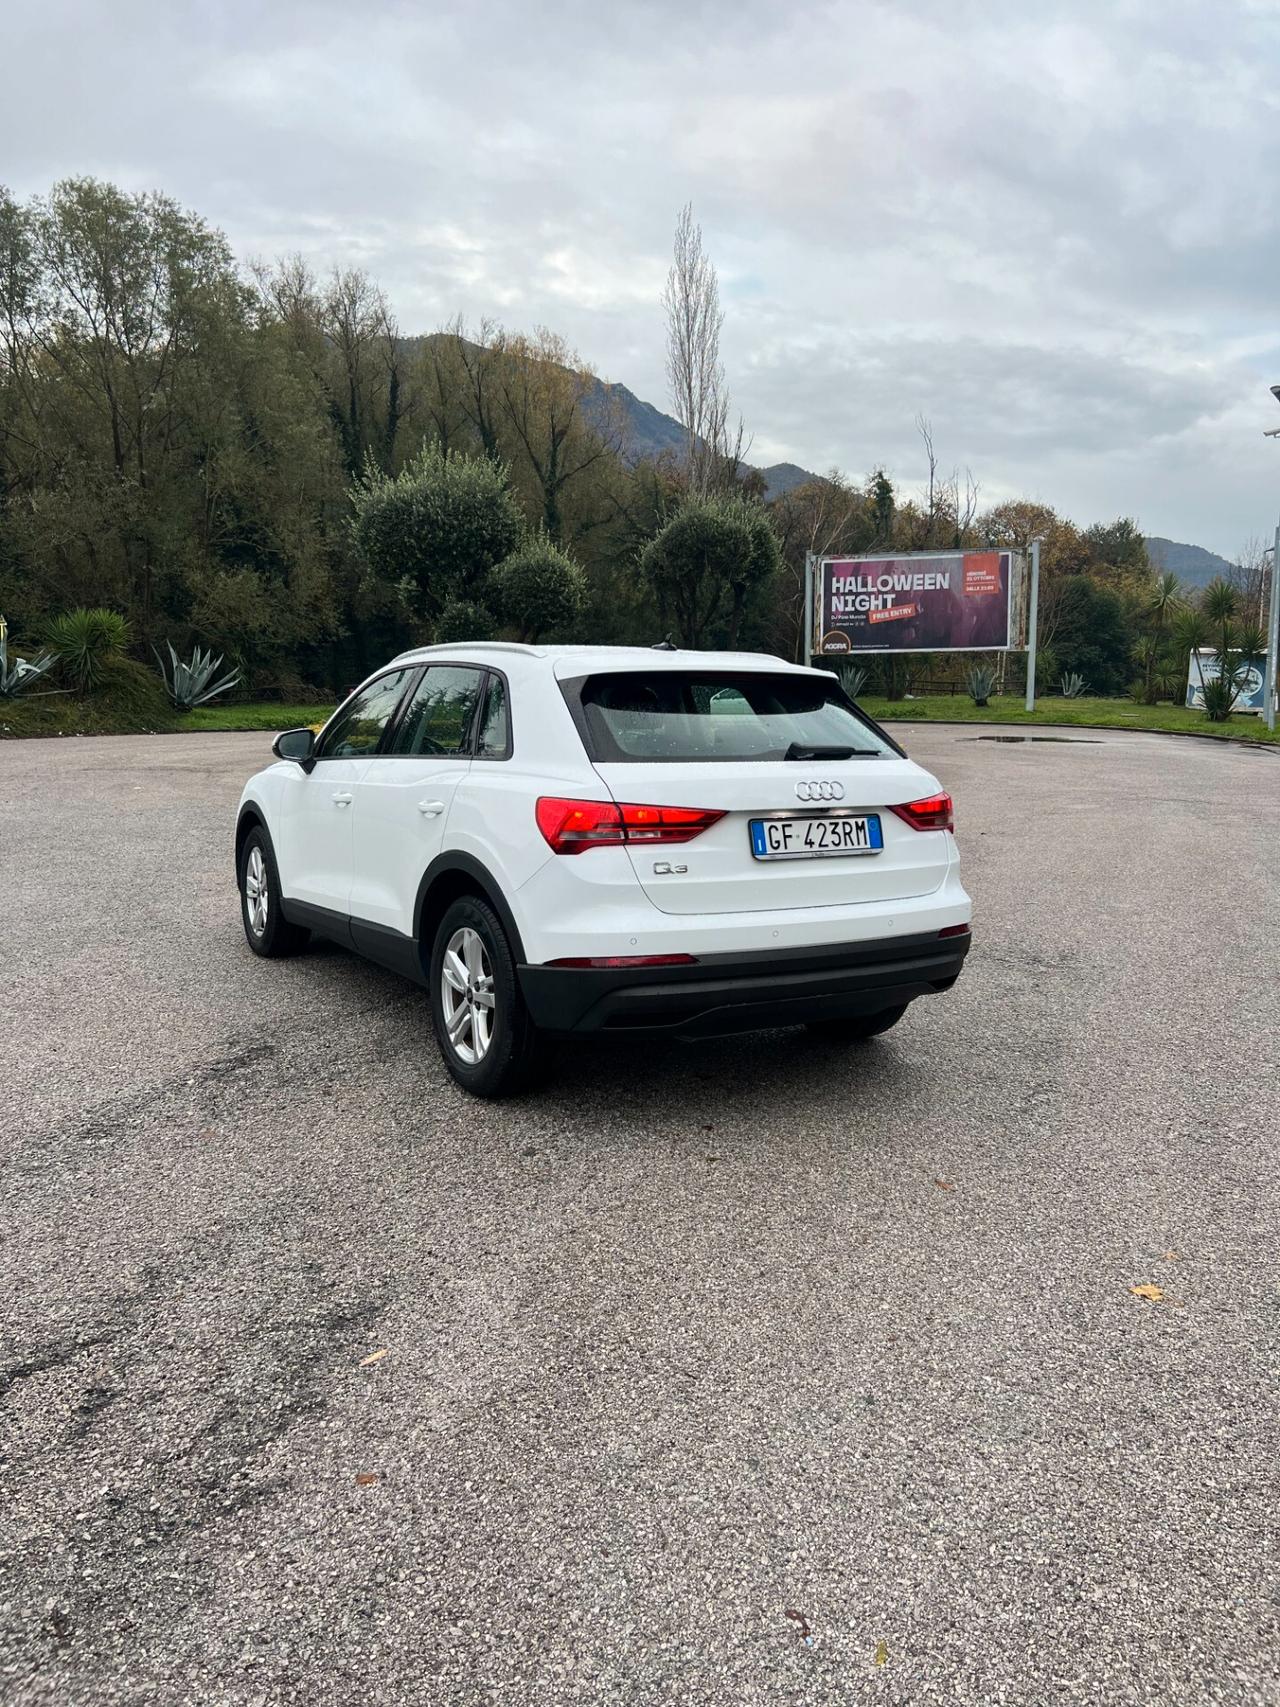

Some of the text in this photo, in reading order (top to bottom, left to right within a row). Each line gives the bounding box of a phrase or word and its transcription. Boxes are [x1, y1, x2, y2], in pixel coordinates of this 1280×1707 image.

[831, 572, 950, 593] HALLOWEEN
[831, 593, 896, 612] NIGHT
[872, 611, 890, 621] FREE
[890, 607, 913, 619] ENTRY
[768, 823, 793, 850] GF
[804, 820, 868, 848] 423RM
[653, 862, 688, 875] Q3
